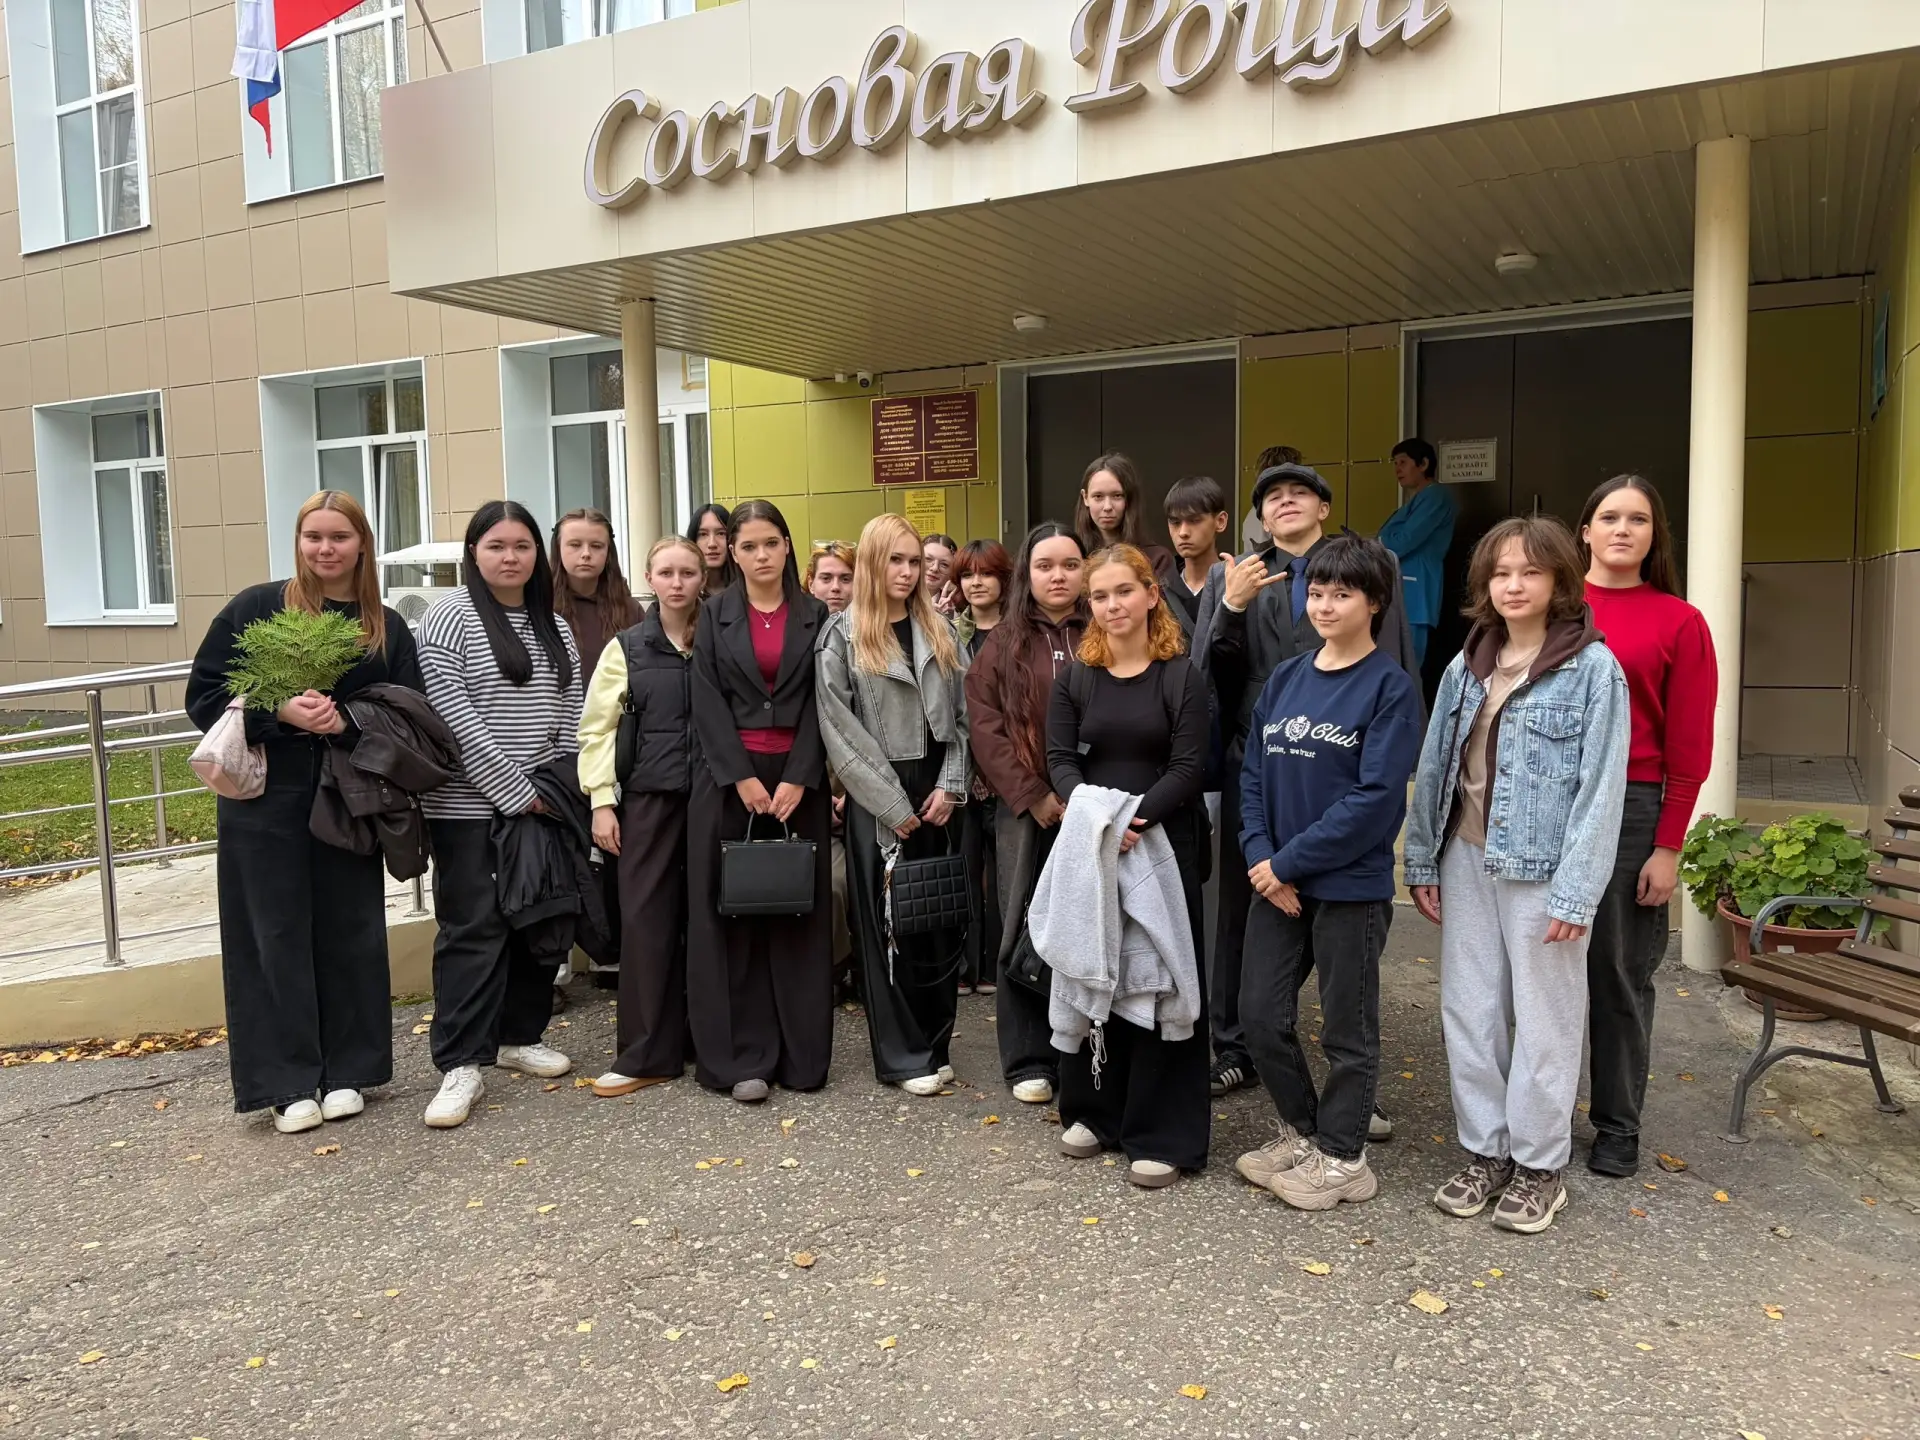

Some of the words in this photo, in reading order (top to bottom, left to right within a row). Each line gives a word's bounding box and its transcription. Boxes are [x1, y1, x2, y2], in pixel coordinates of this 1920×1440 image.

[584, 25, 1047, 209] Сосновая
[1064, 0, 1452, 112] Роща
[1310, 722, 1360, 748] Club
